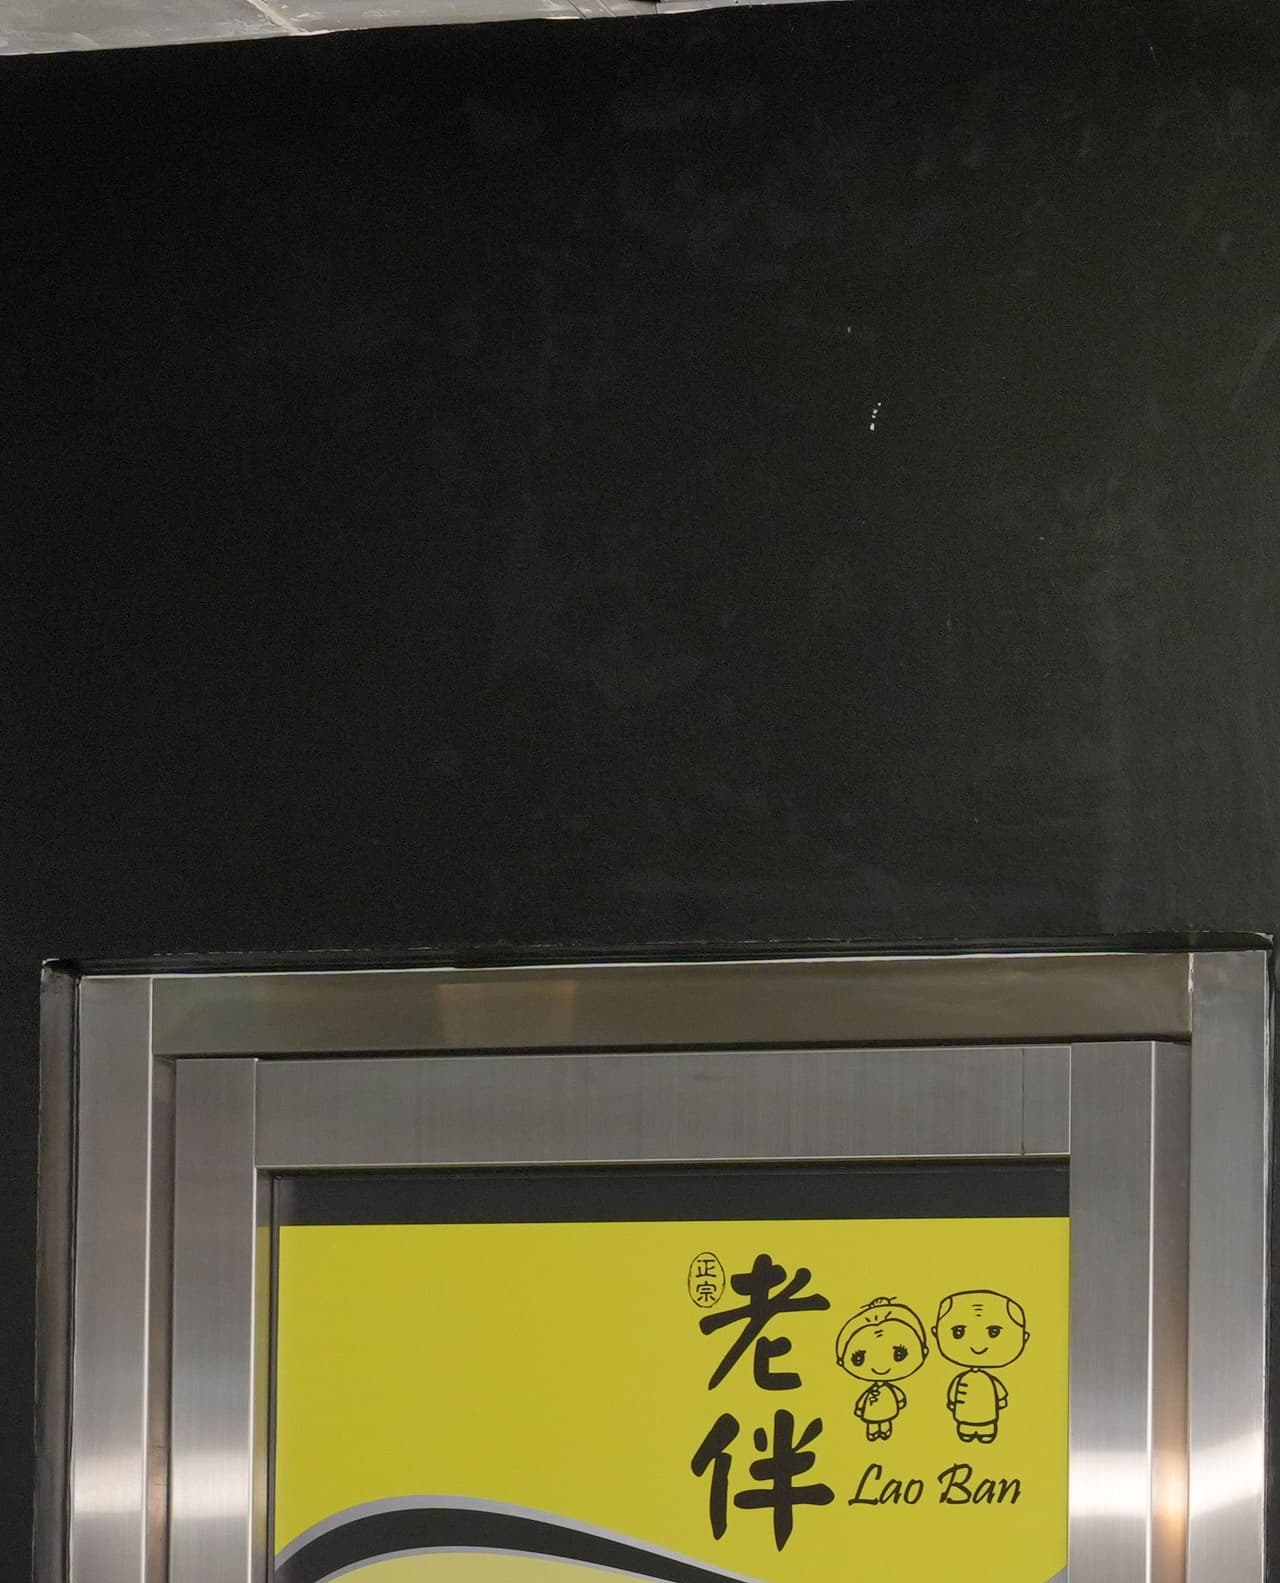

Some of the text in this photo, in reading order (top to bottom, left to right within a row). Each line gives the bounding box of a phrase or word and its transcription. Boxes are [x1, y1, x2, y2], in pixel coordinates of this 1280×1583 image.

[694, 1257, 718, 1304] 正宗
[691, 1254, 835, 1551] 老伴
[848, 1464, 1020, 1506] Lao Ban
